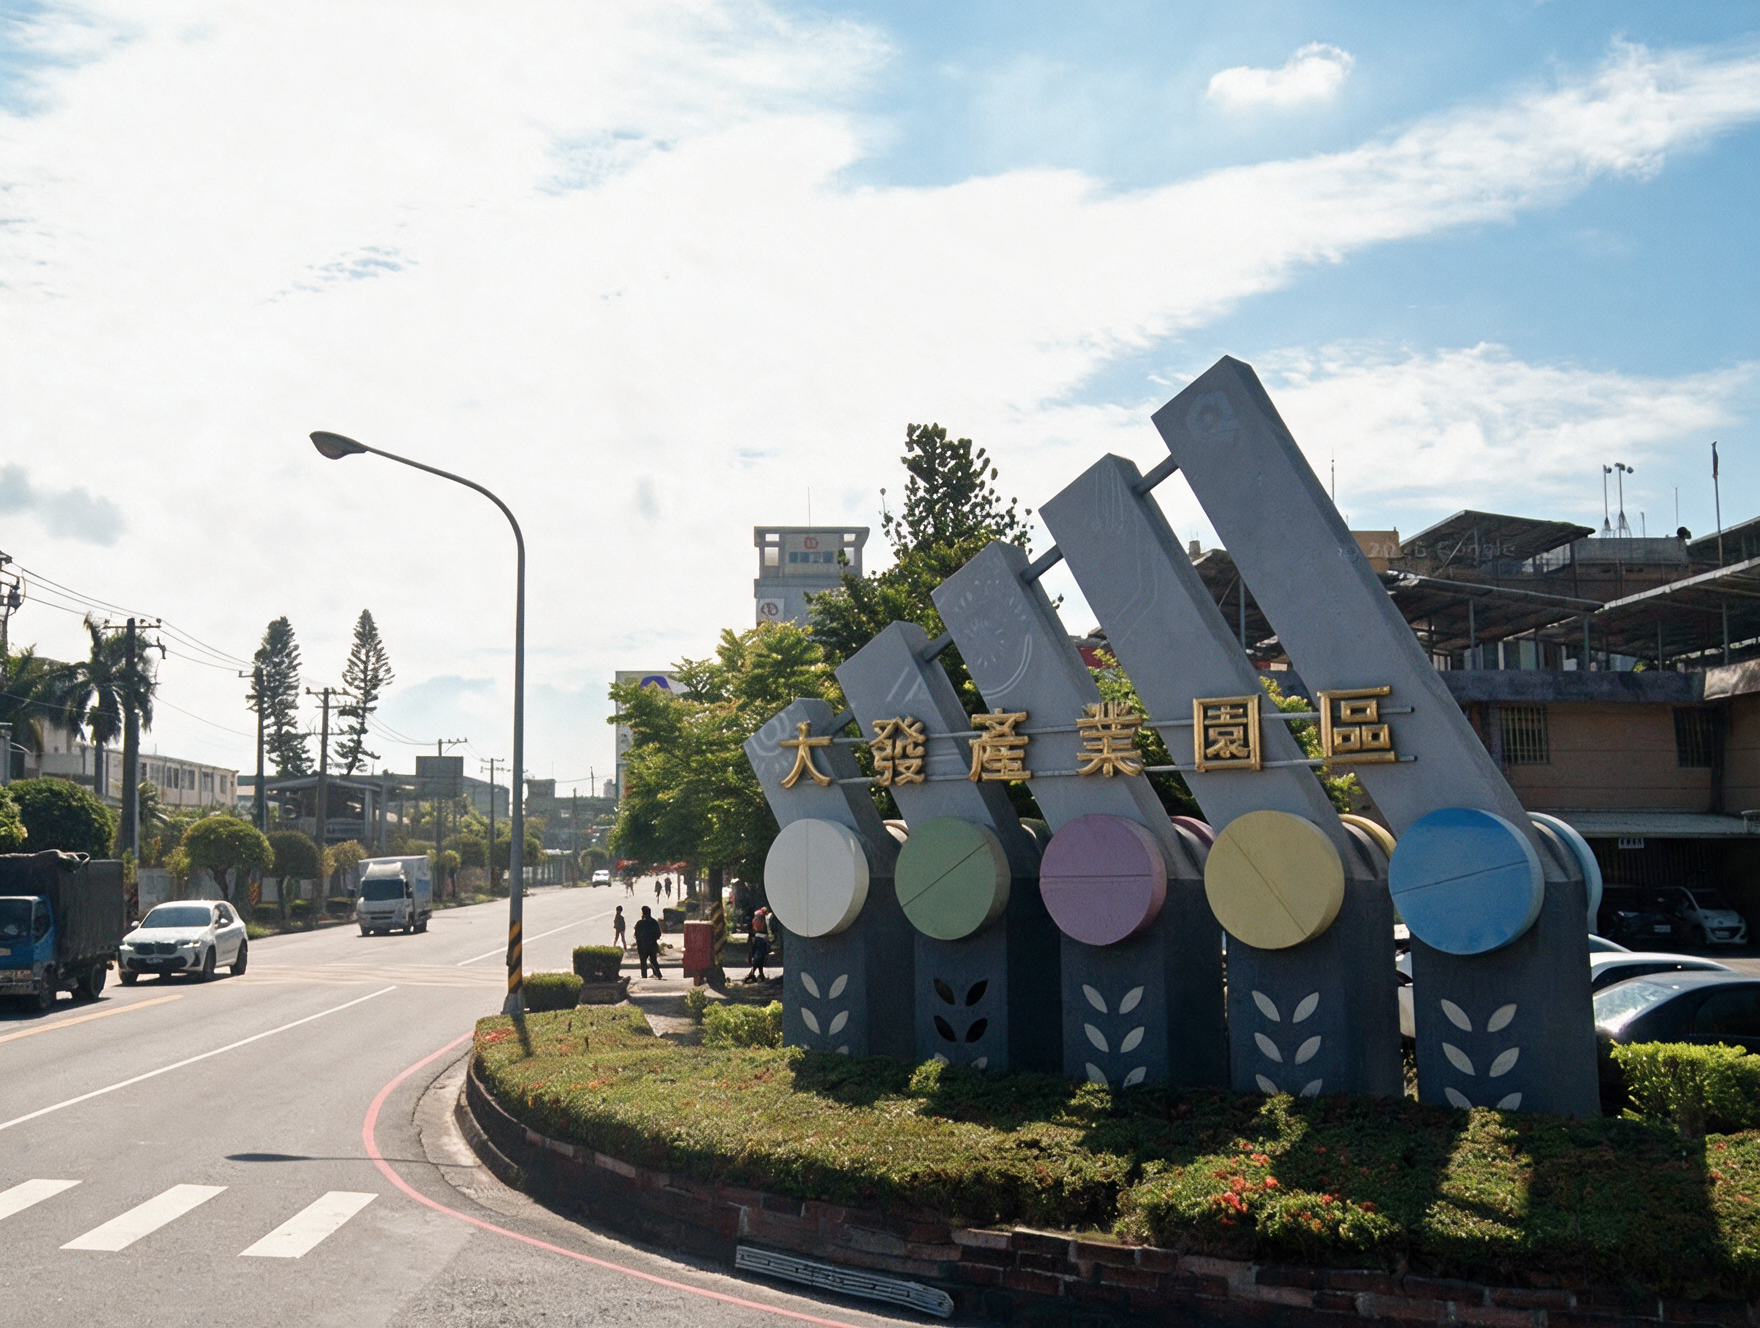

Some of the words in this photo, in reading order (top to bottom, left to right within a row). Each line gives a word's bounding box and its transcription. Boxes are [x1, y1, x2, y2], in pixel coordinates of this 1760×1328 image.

[779, 686, 1396, 788] 大發產業園區
